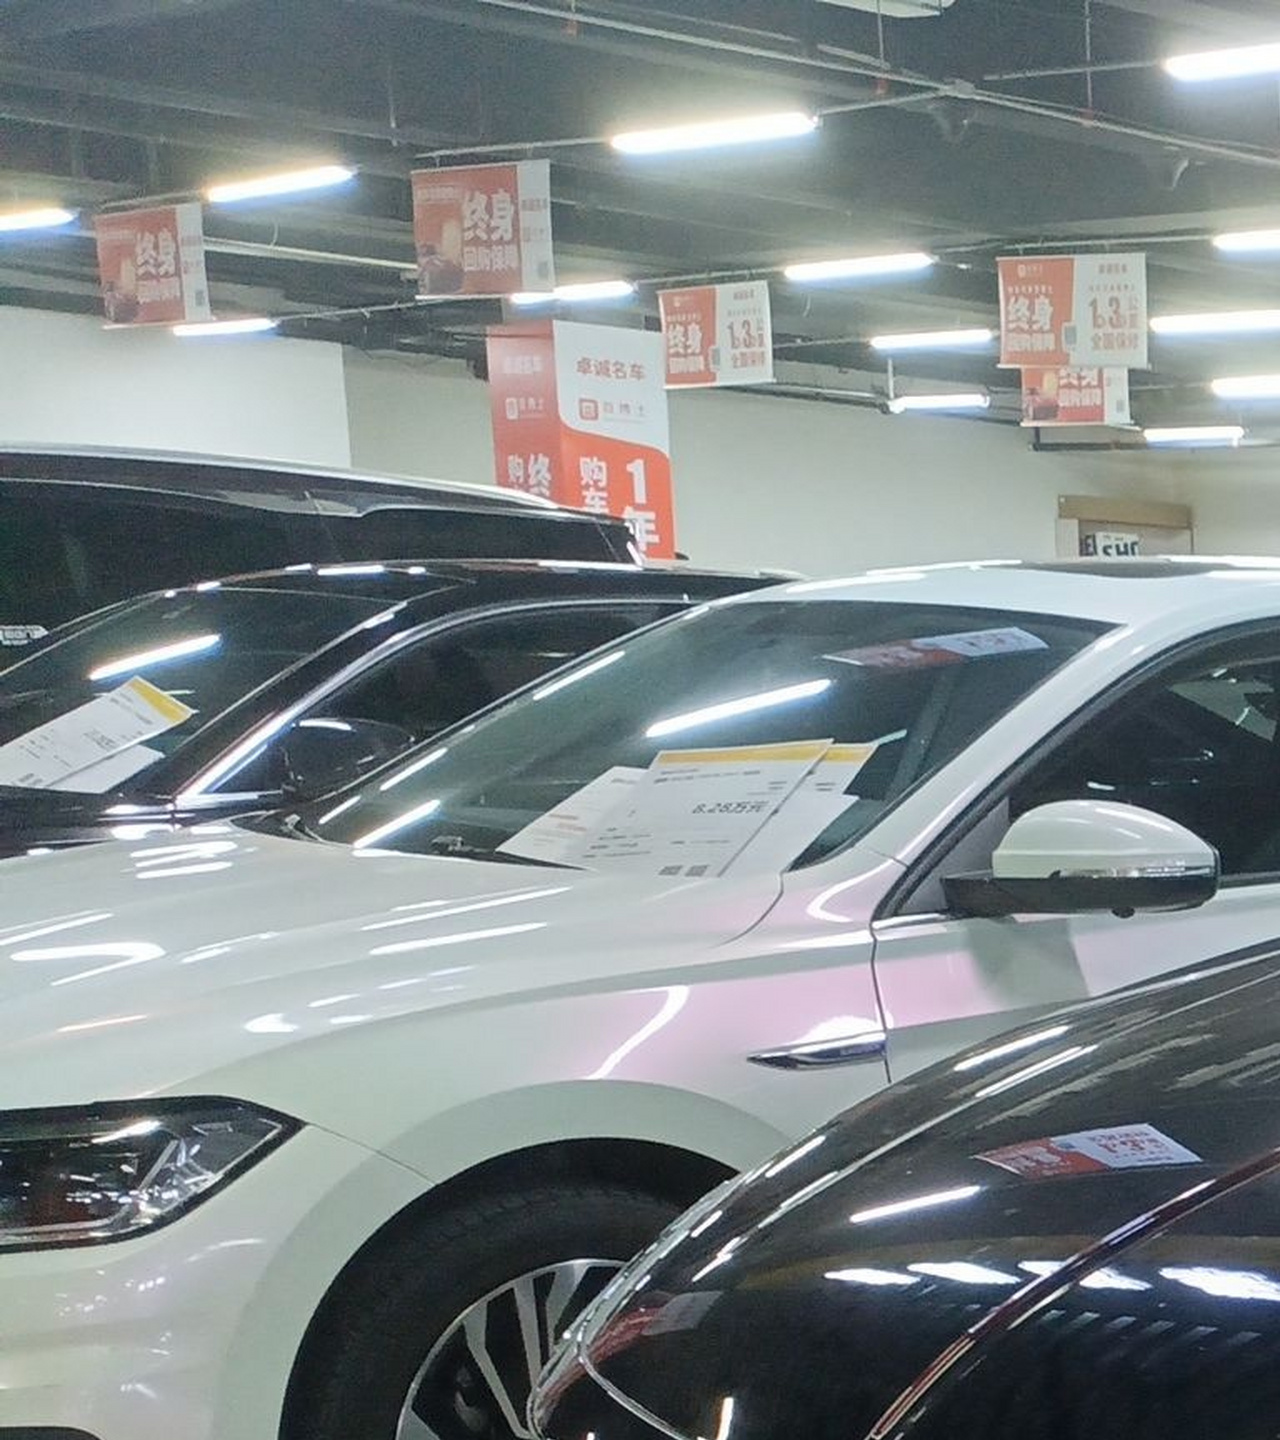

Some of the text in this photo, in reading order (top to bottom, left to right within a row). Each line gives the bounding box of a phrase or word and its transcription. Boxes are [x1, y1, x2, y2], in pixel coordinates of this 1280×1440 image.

[461, 187, 515, 242] 终身
[135, 228, 177, 276] 终身
[1007, 294, 1054, 332] 终身
[667, 321, 703, 356] 终身
[576, 356, 646, 381] 卓诚名车
[507, 452, 525, 491] 购
[527, 452, 551, 497] 终
